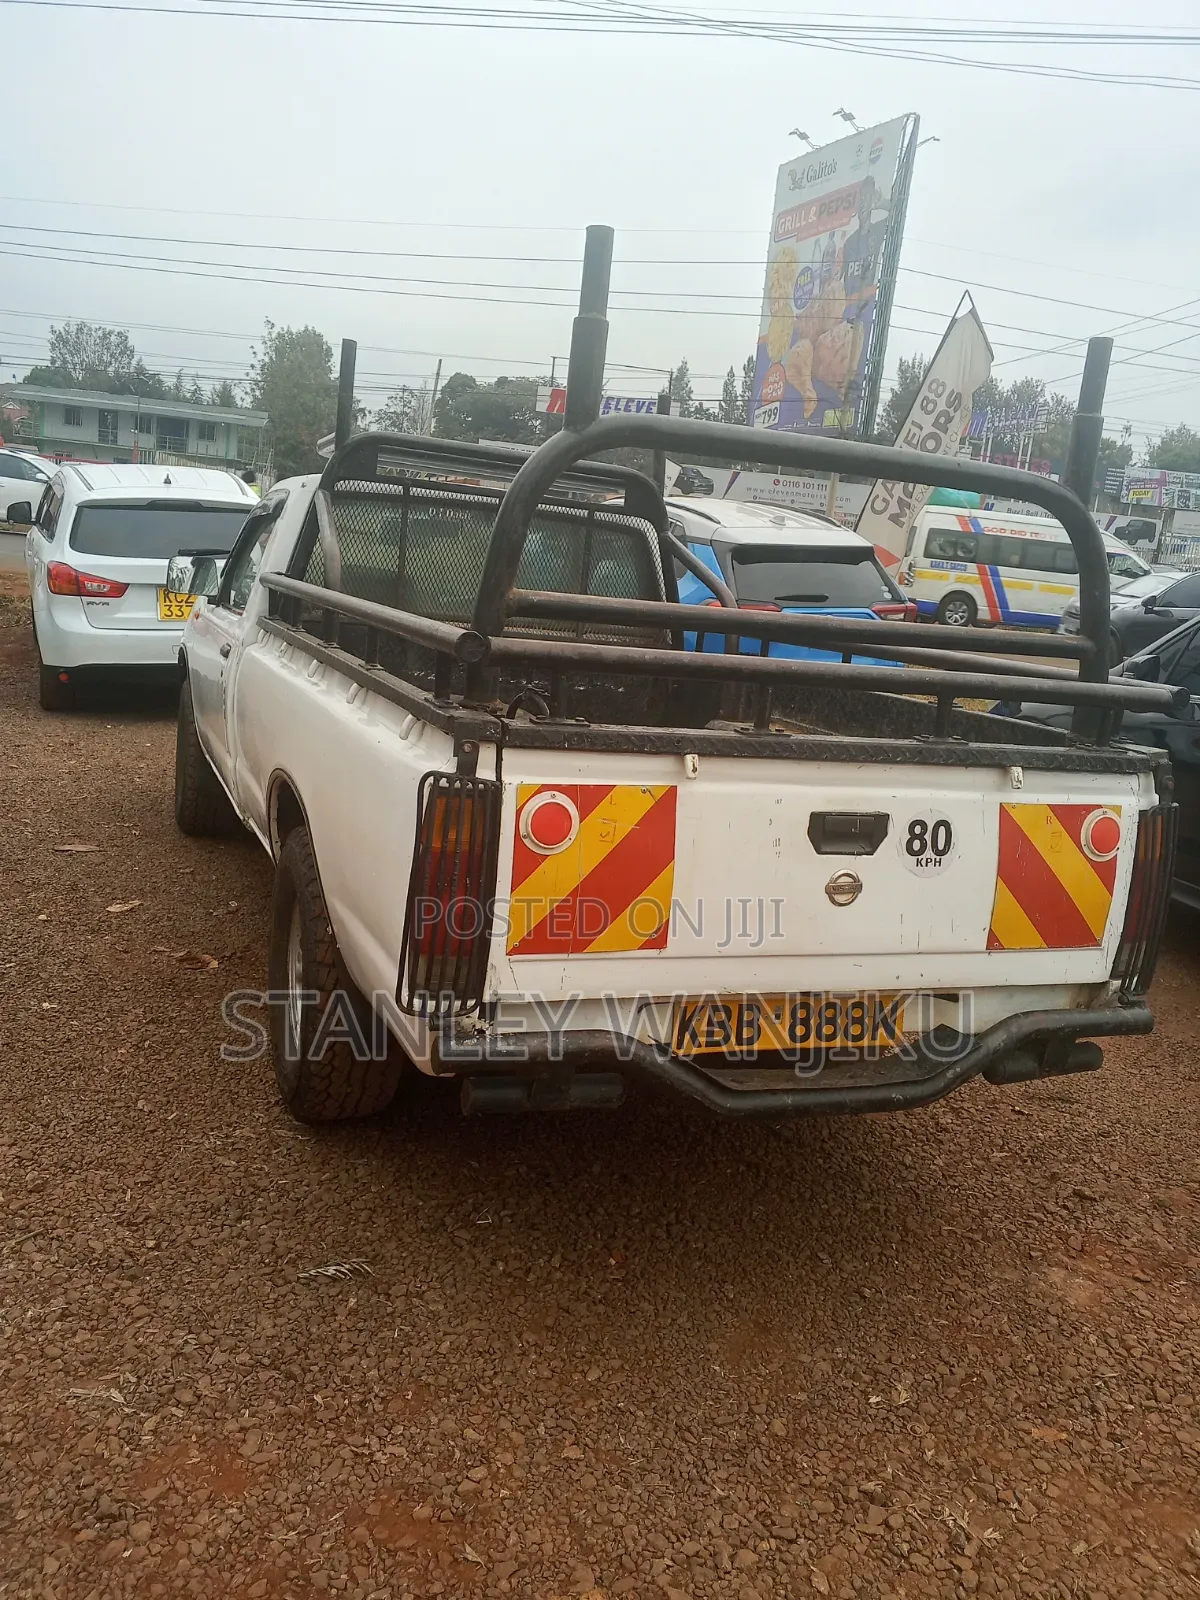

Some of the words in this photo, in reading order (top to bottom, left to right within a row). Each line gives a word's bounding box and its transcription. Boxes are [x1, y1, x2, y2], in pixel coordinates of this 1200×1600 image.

[806, 159, 838, 183] Galito's
[778, 211, 805, 234] GRILL
[808, 206, 817, 223] &
[819, 191, 857, 218] PEPSI
[602, 397, 657, 414] ELEVE
[919, 378, 947, 416] 88
[762, 406, 779, 424] 799
[888, 388, 963, 529] MOORS
[782, 480, 800, 489] 0116
[802, 482, 815, 490] 101
[163, 604, 195, 618] 33
[906, 819, 953, 857] 80
[915, 858, 943, 868] KPH
[676, 1002, 762, 1050] KBB
[788, 1000, 900, 1044] 888K
